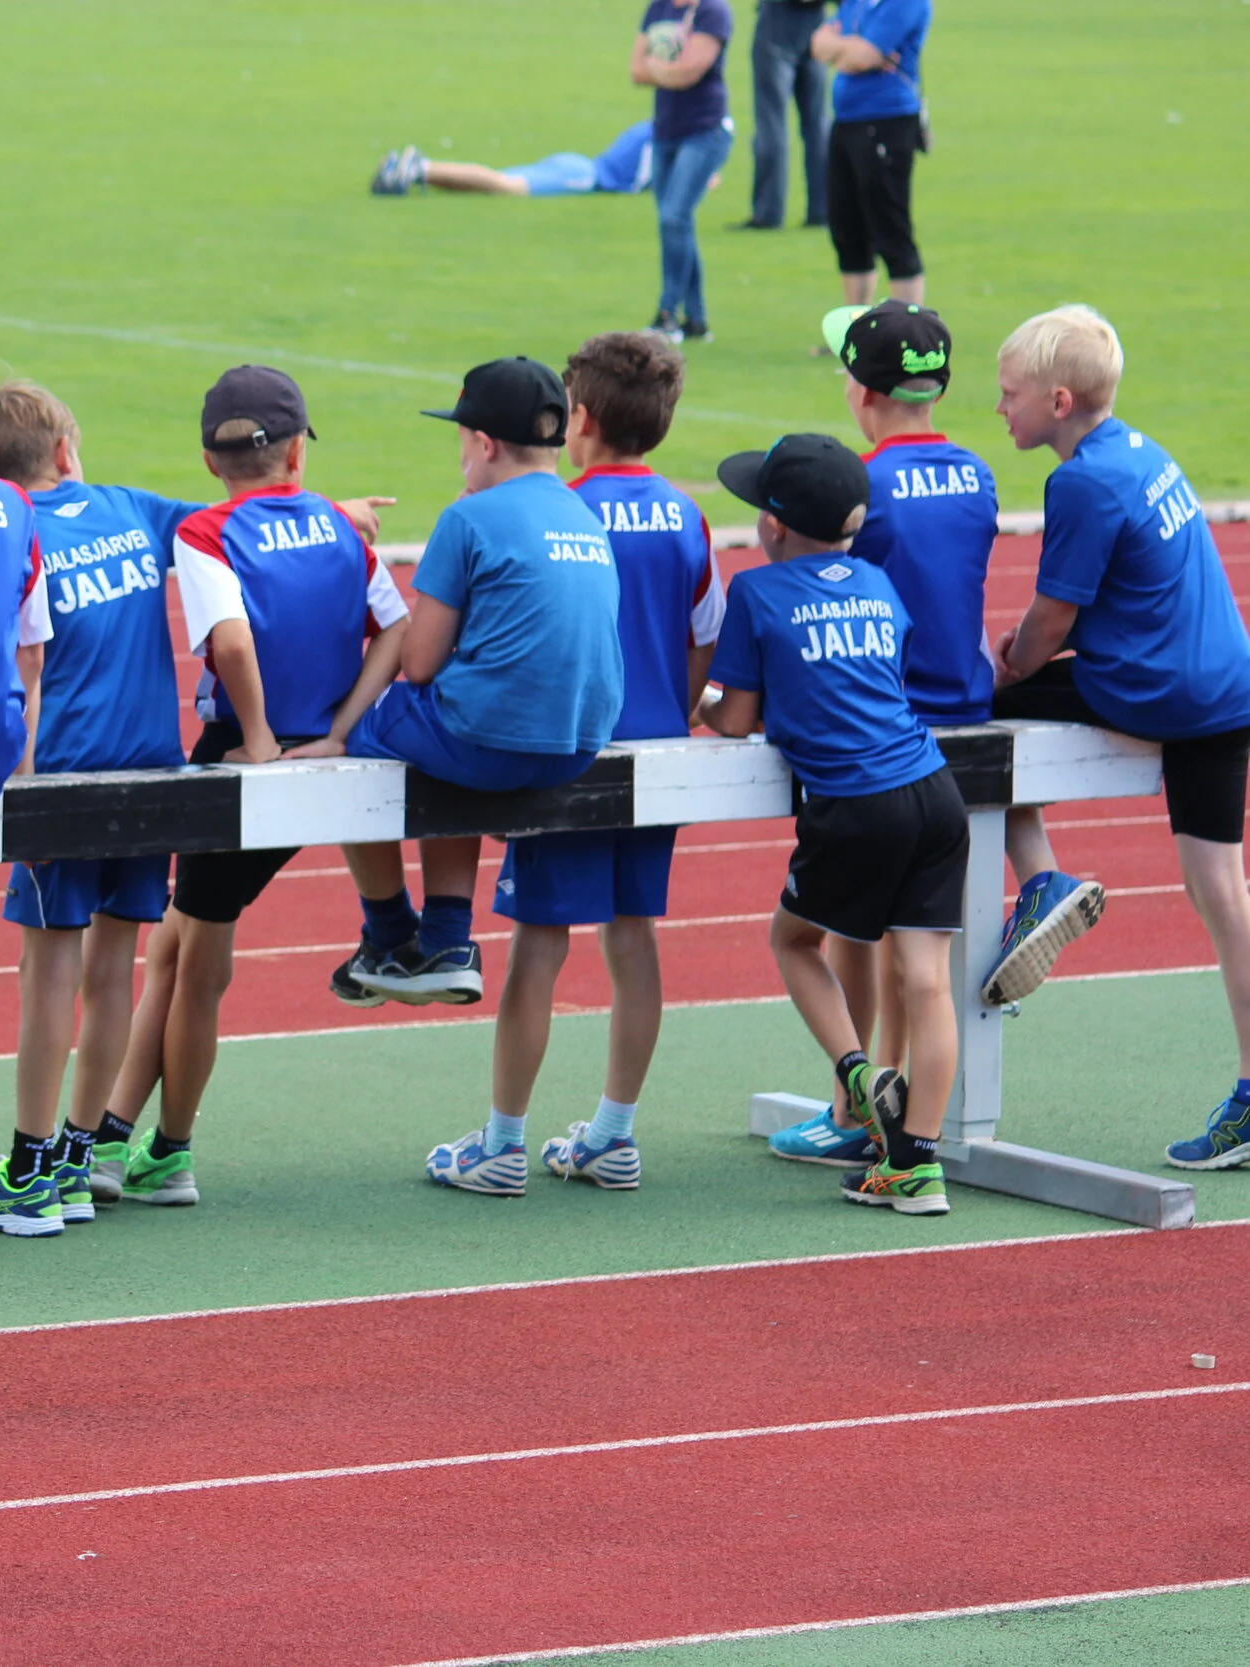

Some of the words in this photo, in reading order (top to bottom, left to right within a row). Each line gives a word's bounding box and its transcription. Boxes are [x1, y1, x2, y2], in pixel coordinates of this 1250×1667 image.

[892, 464, 980, 500] JALAS
[600, 501, 683, 532] JALAS
[1158, 480, 1201, 540] JALA
[43, 528, 150, 575] JALASJÄRVEN
[257, 514, 337, 552] JALAS
[549, 543, 610, 566] JALAS
[54, 554, 161, 614] JALAS
[791, 596, 893, 625] JALASJÄRVEN
[801, 620, 896, 662] JALAS
